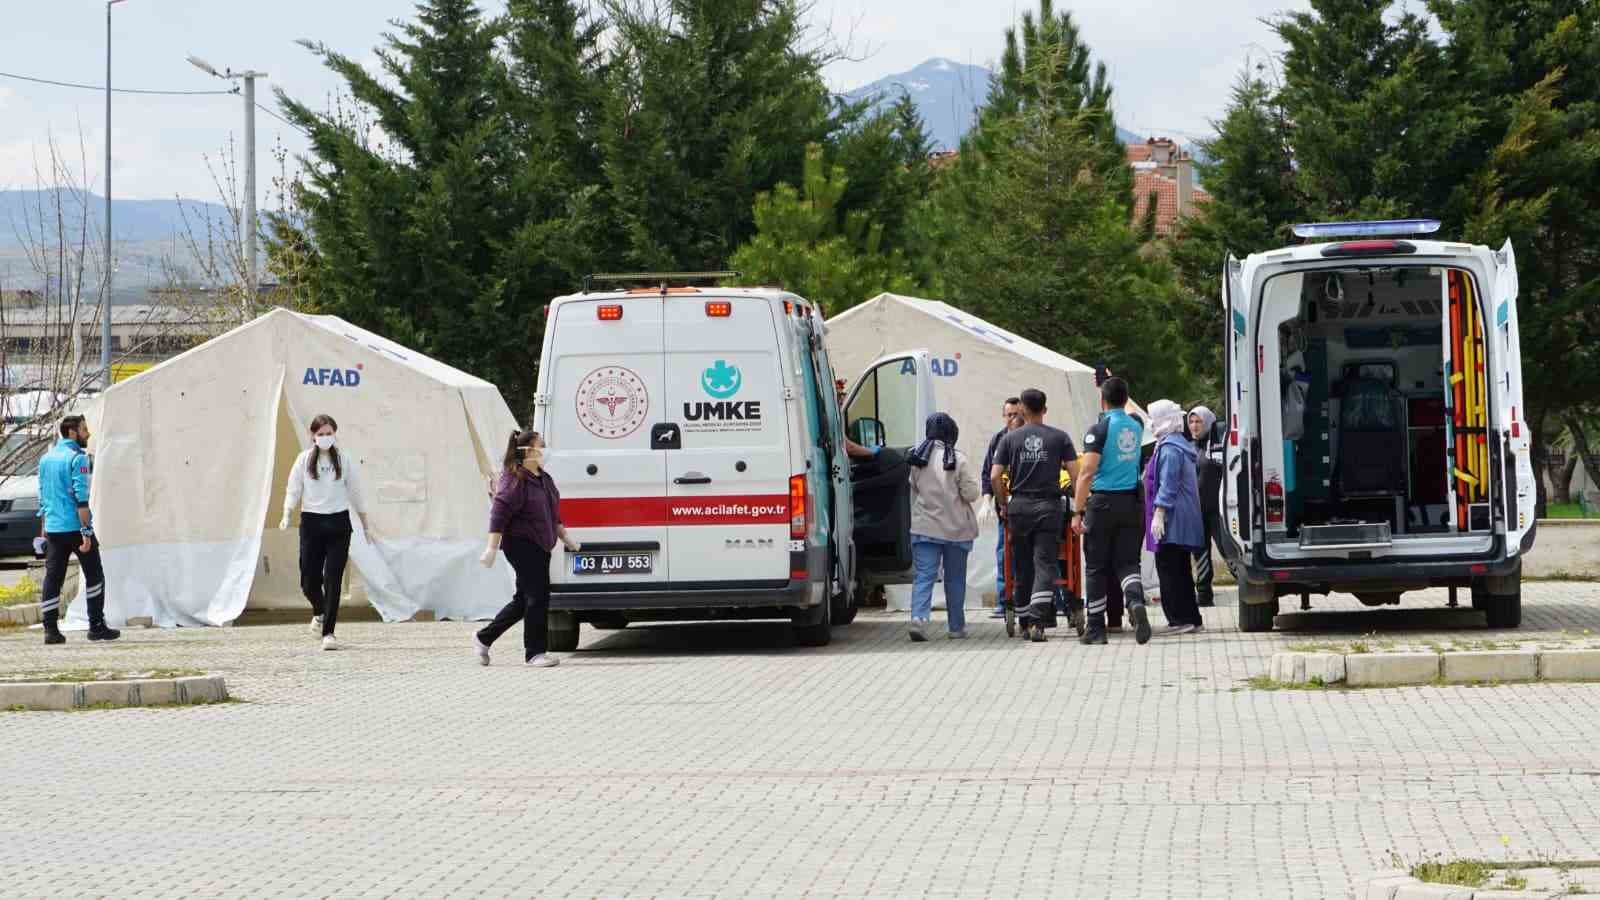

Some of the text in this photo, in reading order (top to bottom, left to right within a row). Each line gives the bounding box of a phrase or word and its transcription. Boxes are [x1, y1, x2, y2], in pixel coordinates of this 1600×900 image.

[302, 367, 360, 386] AFAD
[900, 358, 959, 377] AAD
[683, 401, 760, 420] UMKE
[672, 504, 786, 517] www.acilafet.gov.tr
[580, 556, 649, 569] 03 AJU 553
